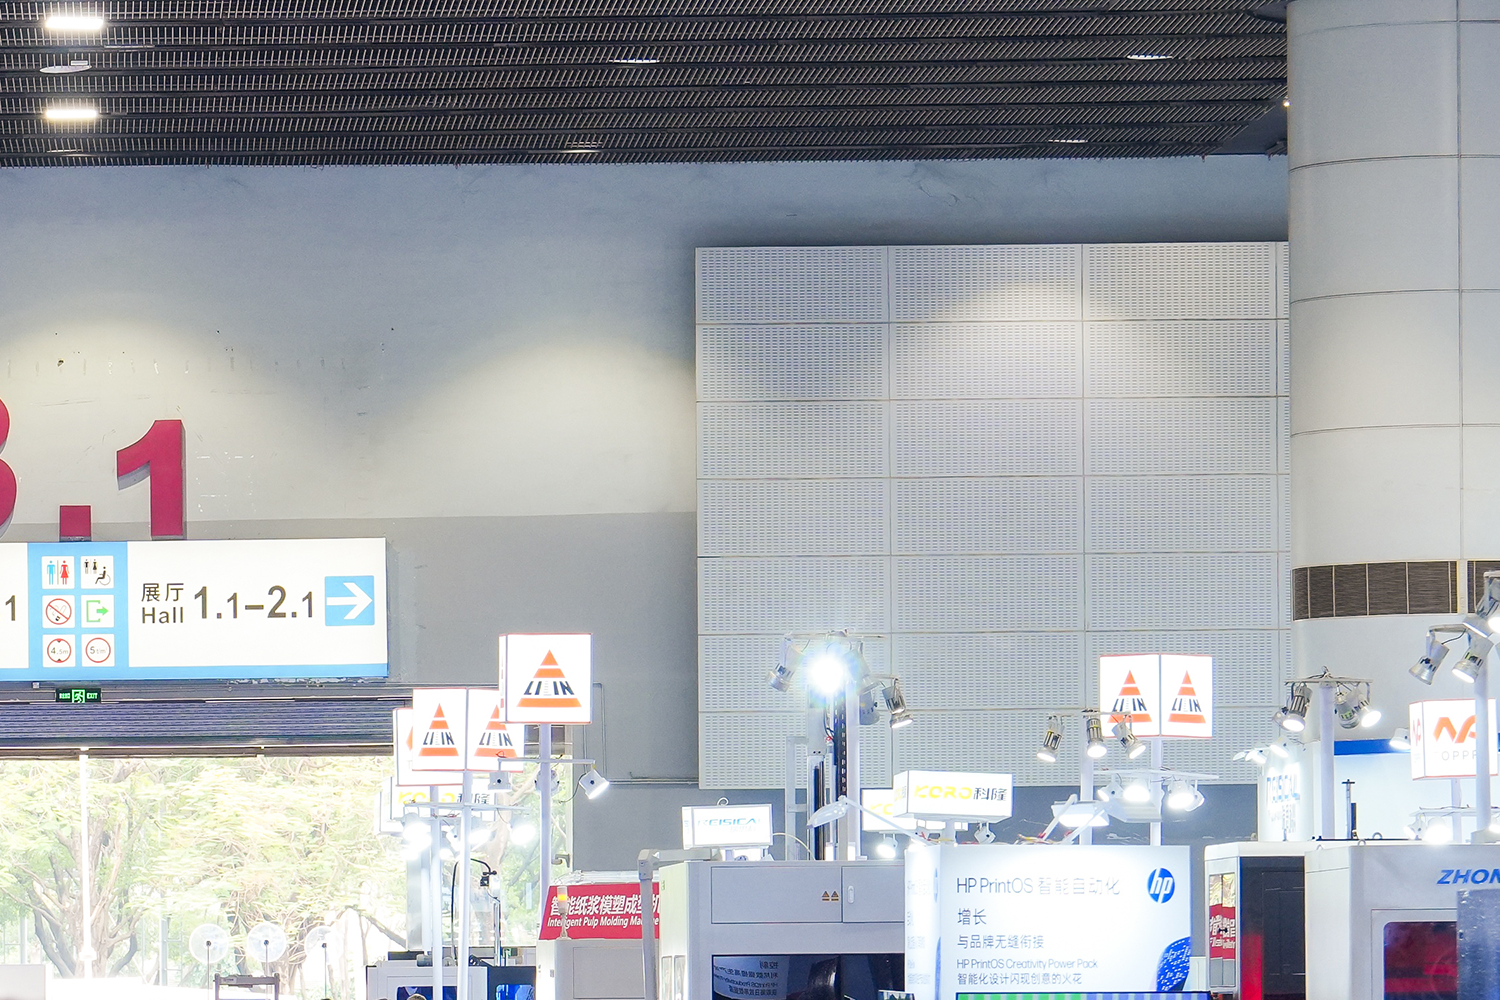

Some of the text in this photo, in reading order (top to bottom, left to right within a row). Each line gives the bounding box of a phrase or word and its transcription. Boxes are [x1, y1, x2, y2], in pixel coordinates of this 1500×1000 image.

[141, 582, 185, 602] 展厅
[141, 606, 185, 624] Hall
[973, 787, 1007, 802] 科隆
[957, 877, 1121, 895] HP PrintOS 智能自动化
[1149, 868, 1174, 903] hp
[547, 917, 582, 929] Inteligent
[583, 916, 598, 929] Pulp
[600, 915, 628, 929] Molding
[957, 908, 987, 925] 增长
[957, 935, 1044, 949] 与品牌无缝衔接
[957, 958, 1098, 971] HP PrintOS Creativity Power Pack
[957, 973, 1083, 985] 智能化设计闪现创意的火花
